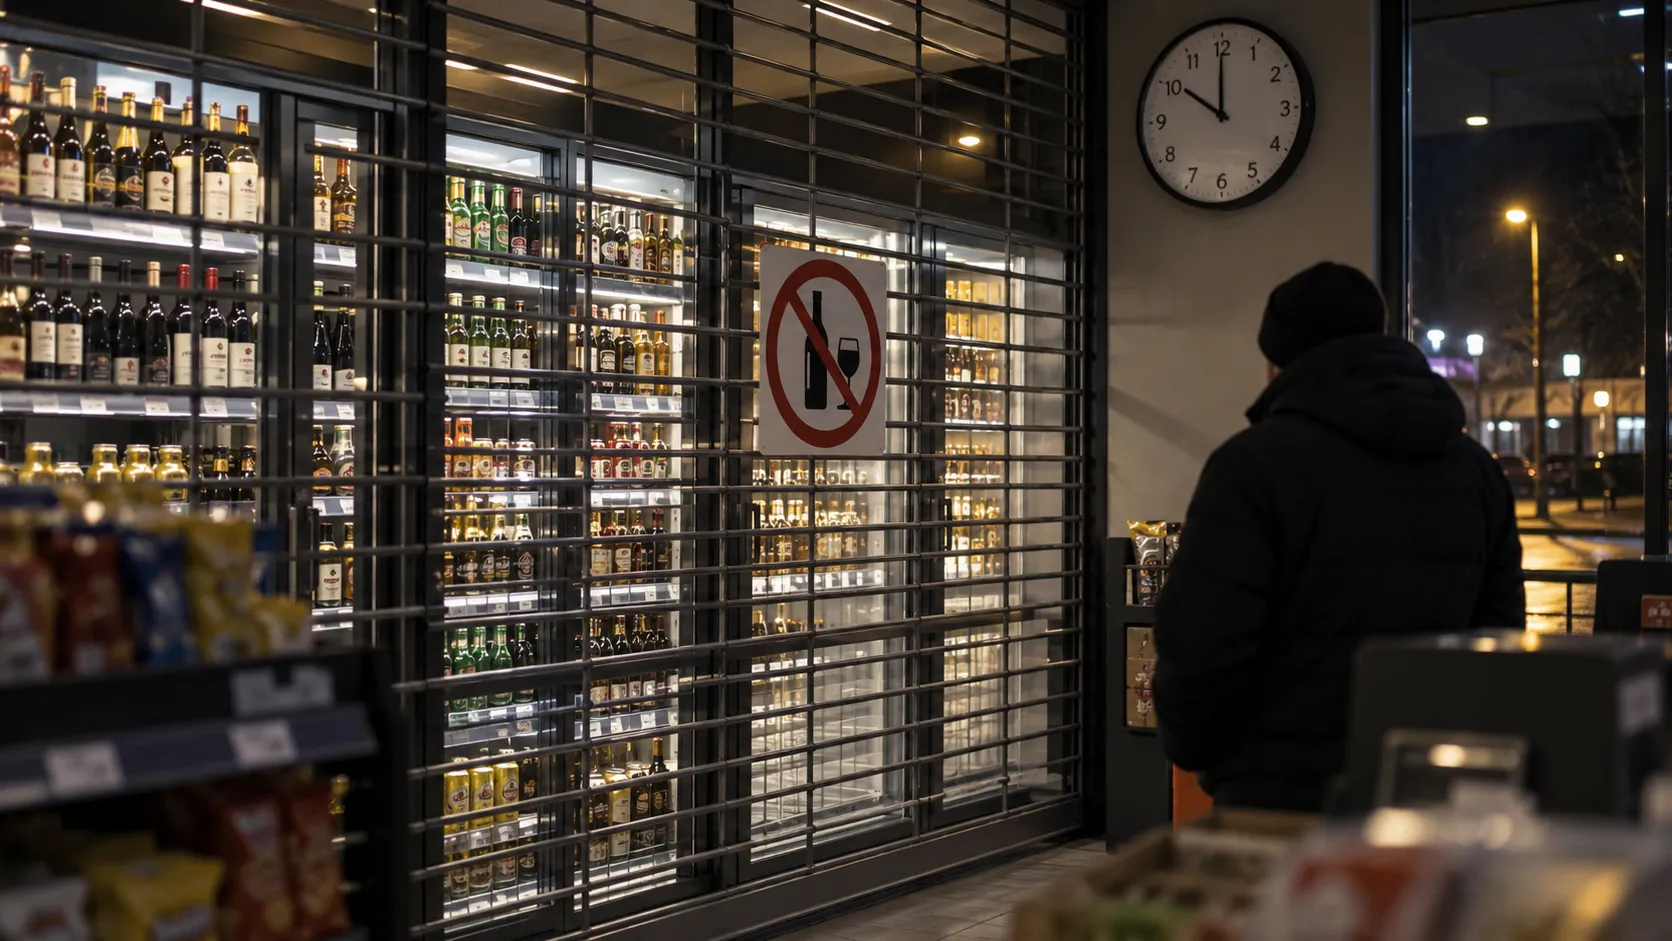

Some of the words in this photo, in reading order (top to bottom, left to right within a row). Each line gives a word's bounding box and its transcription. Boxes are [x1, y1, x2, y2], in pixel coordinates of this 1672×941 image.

[1214, 41, 1230, 57] 12
[1251, 46, 1255, 61] 1
[1187, 54, 1198, 69] 11
[1271, 67, 1281, 82] 2
[1166, 80, 1181, 95] 10
[1280, 101, 1290, 117] 3
[1157, 114, 1166, 129] 9
[1270, 136, 1280, 151] 4
[1166, 146, 1175, 162] 8
[1188, 168, 1198, 183] 7
[1248, 162, 1257, 178] 5
[1217, 174, 1227, 188] 6
